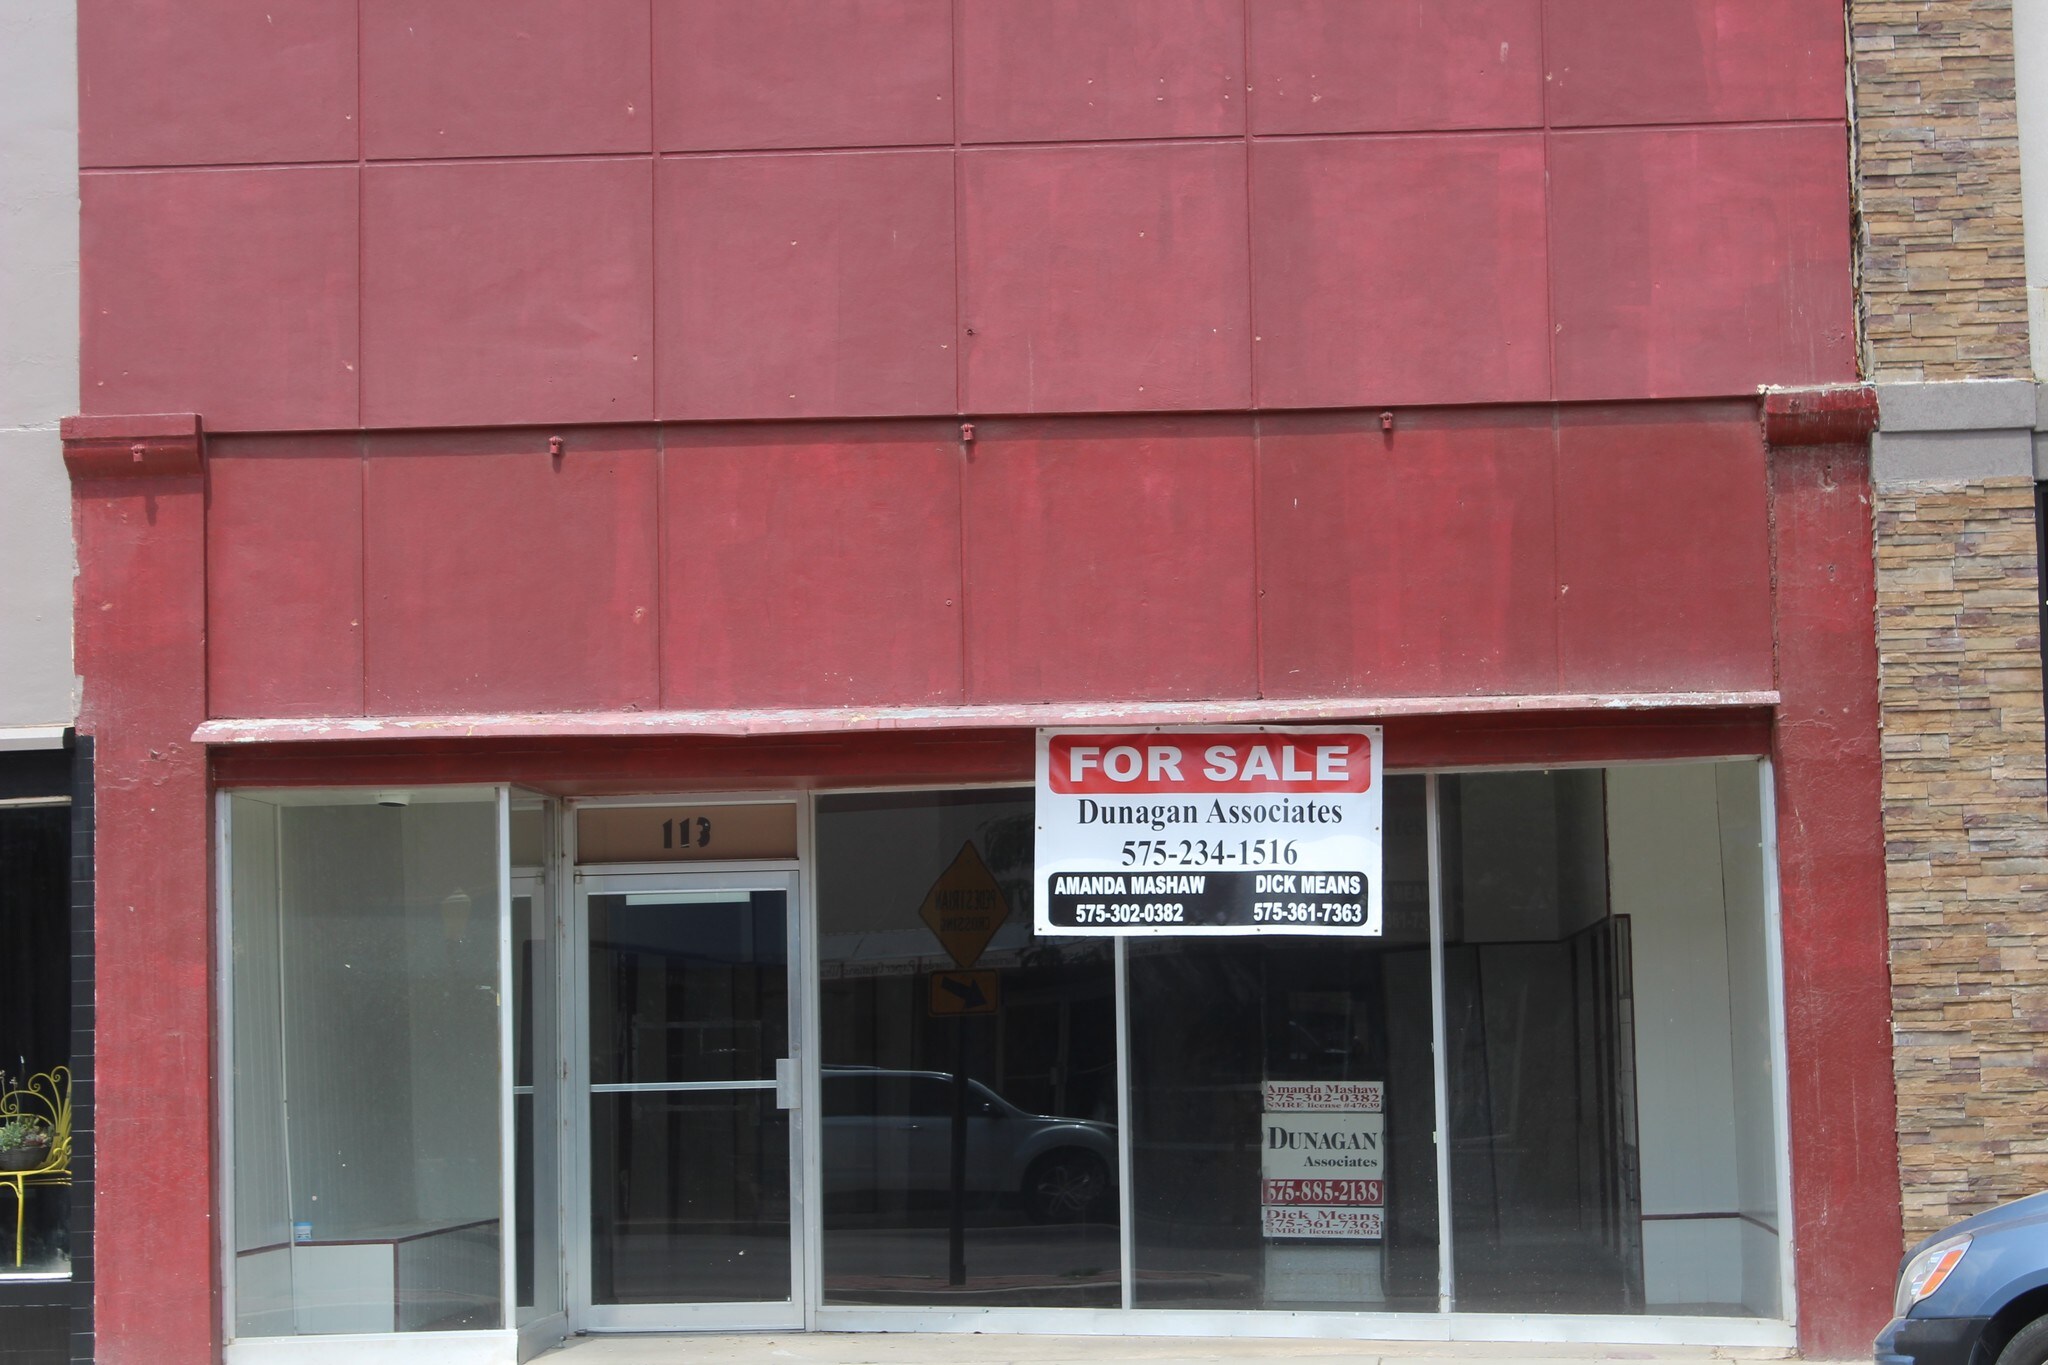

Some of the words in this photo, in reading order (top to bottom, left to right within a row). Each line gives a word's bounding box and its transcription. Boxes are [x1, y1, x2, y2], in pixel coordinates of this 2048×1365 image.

[1069, 746, 1184, 782] FOR
[1202, 745, 1349, 781] SALE
[1077, 798, 1198, 831] Dunagan
[1205, 797, 1342, 824] Associates
[662, 816, 711, 849] 113
[1121, 839, 1298, 866] 575-234-1516
[1054, 876, 1127, 895] AMANDA
[1131, 876, 1206, 894] MASHAW
[1255, 875, 1297, 894] DICK
[1301, 875, 1361, 894] MEANS
[1076, 903, 1184, 922] 575-302-0382
[1253, 902, 1362, 921] 575-361-7363
[1266, 1094, 1379, 1102] 575-302-0382
[1267, 1084, 1321, 1094] Amanda
[1325, 1084, 1379, 1094] Mashaw
[1268, 1127, 1377, 1150] DUNAGAN
[1304, 1156, 1378, 1168] Associates
[1269, 1181, 1379, 1201] 575-885-2138
[1266, 1210, 1309, 1220] Dick
[1317, 1210, 1380, 1221] Means
[1266, 1220, 1379, 1229] 575-361-7363
